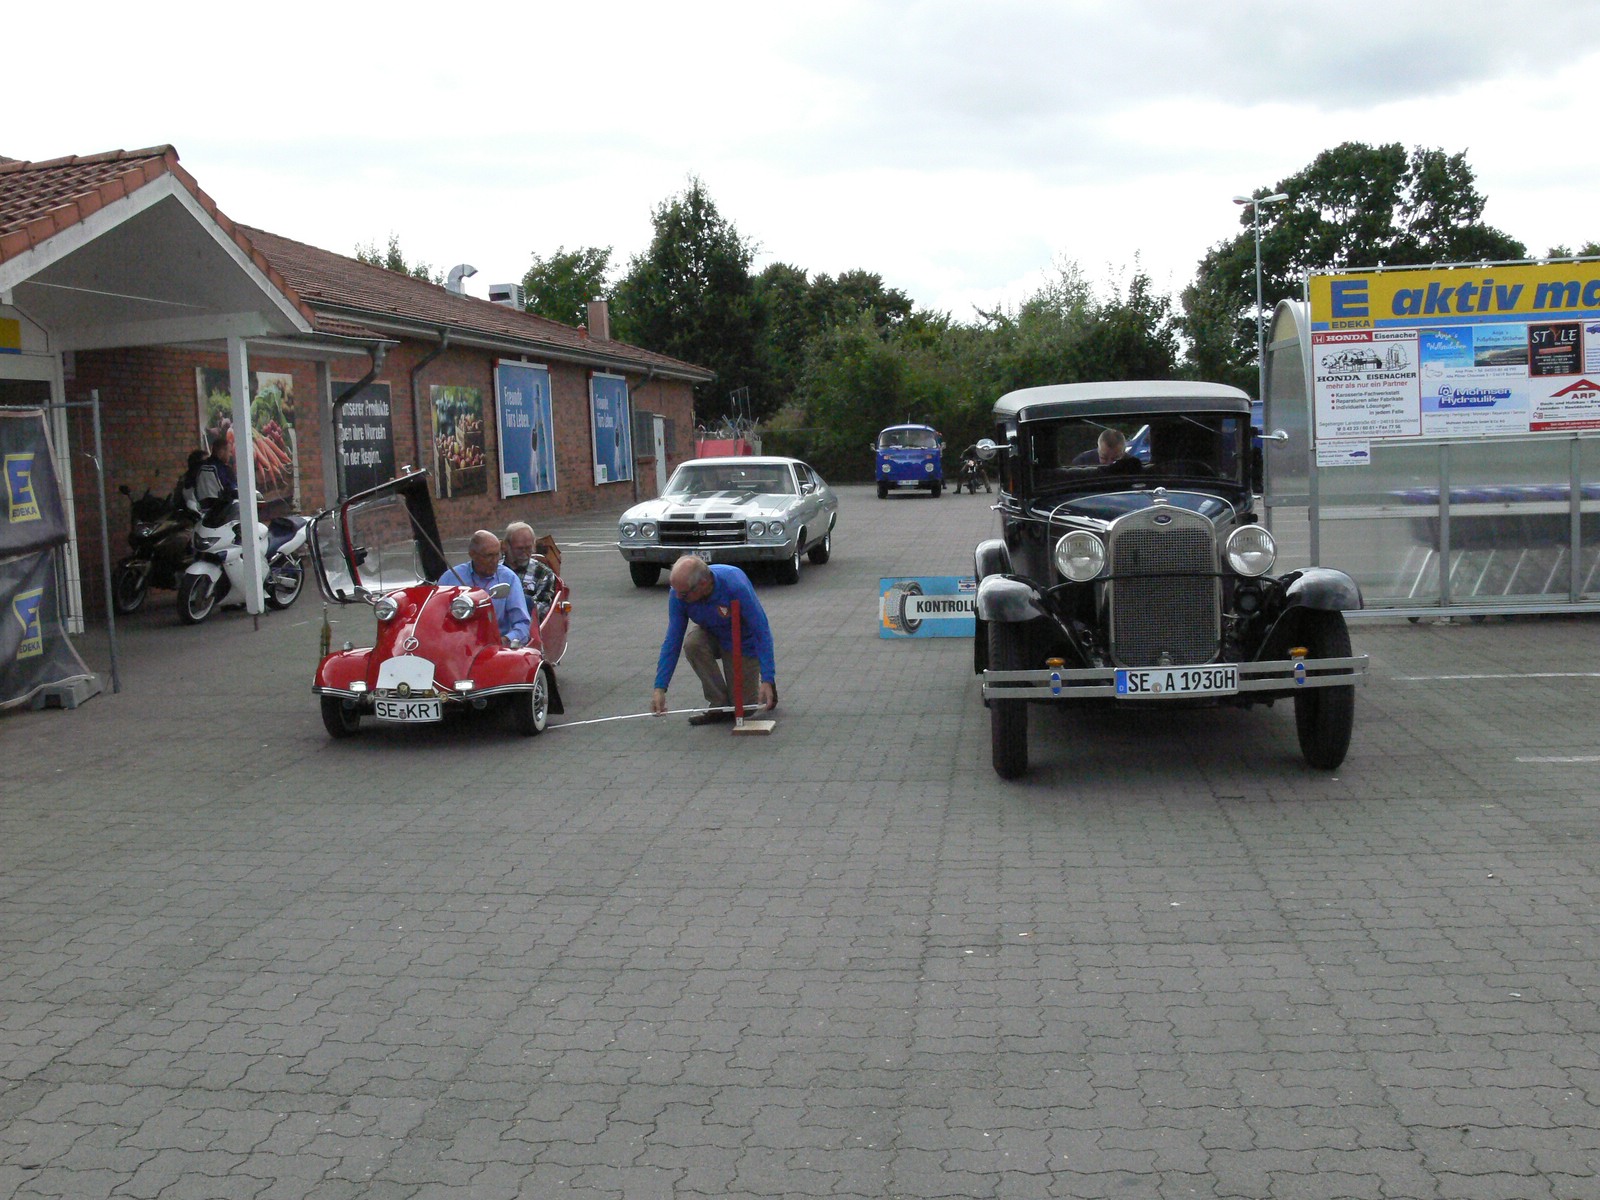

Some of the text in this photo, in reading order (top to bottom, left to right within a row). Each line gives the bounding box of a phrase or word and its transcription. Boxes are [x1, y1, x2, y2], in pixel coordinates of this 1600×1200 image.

[1391, 278, 1524, 316] aktiv
[1331, 319, 1371, 329] EDEKA
[1326, 331, 1416, 342] HONDA Eisenacher
[1531, 325, 1578, 343] STYLE
[1316, 372, 1417, 382] HONDA EISENACHER
[1456, 387, 1512, 396] Mohnsen
[1441, 395, 1497, 405] Hydraulik
[1128, 673, 1151, 692] SE
[1180, 670, 1235, 691] 1930H
